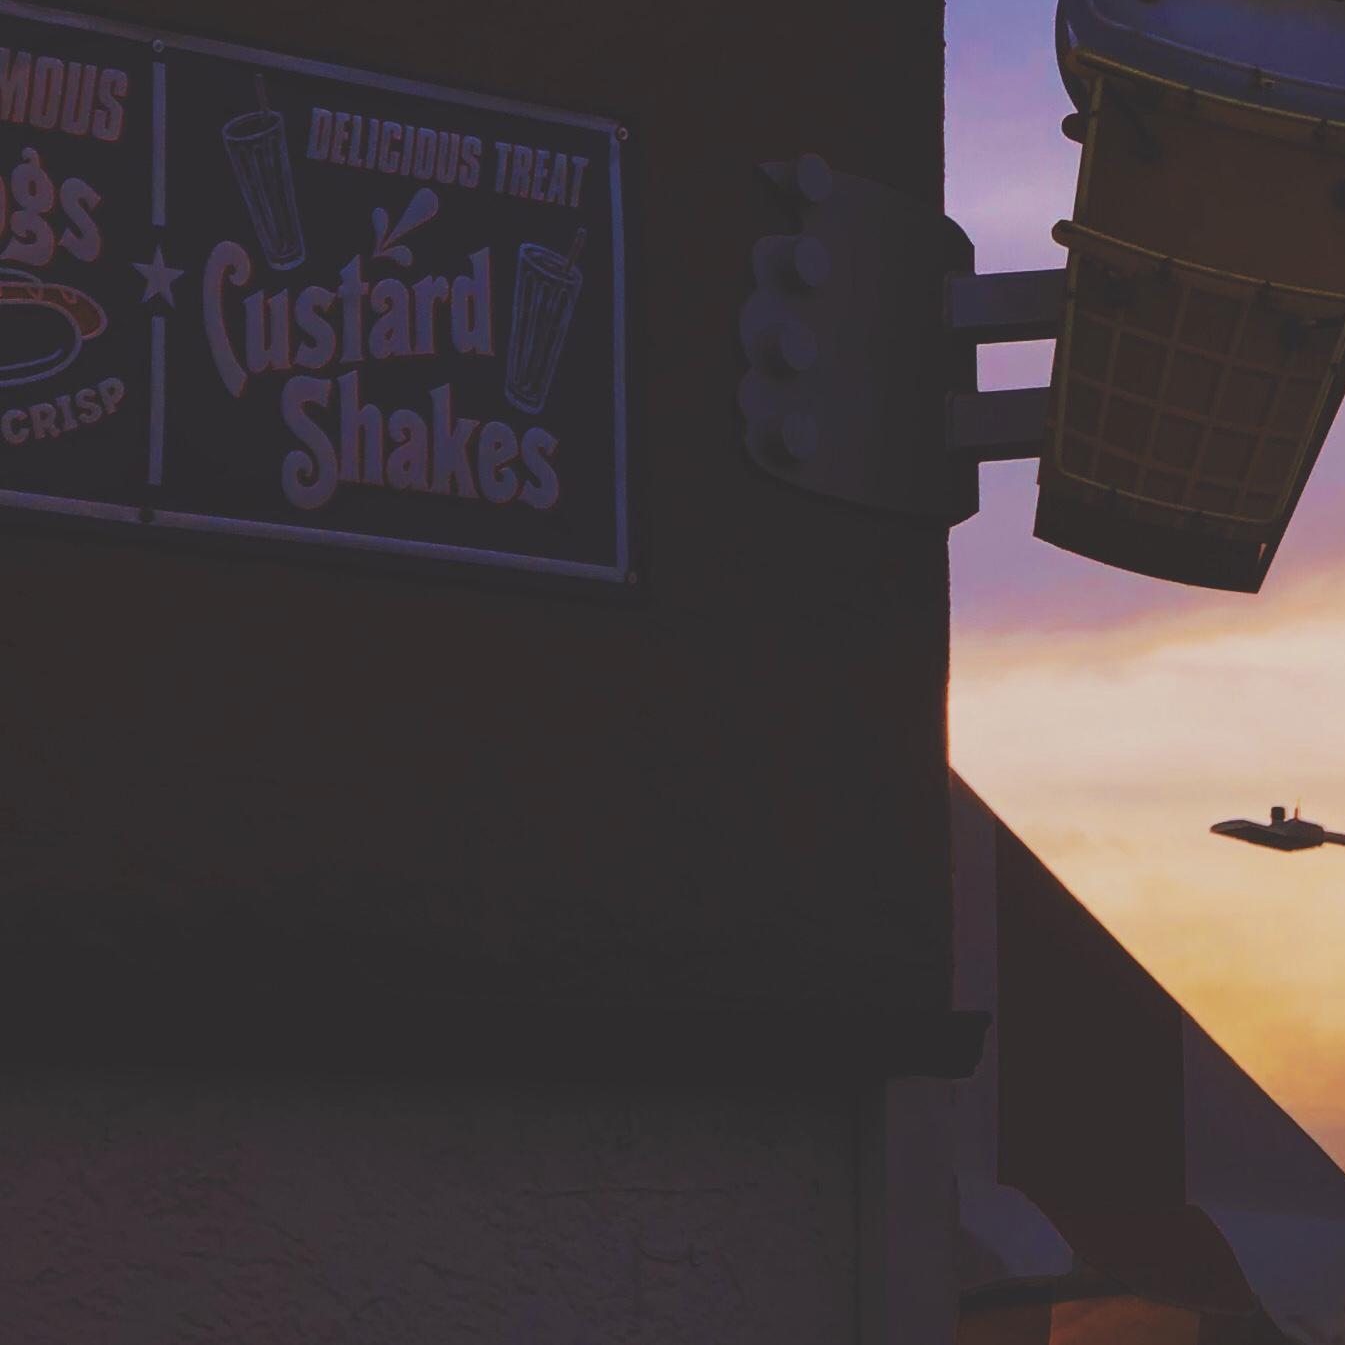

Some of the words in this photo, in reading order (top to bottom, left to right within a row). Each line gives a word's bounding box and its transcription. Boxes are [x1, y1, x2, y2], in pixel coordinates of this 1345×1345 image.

[0, 147, 102, 267] gs
[306, 107, 482, 188] DELICIOUS
[494, 140, 589, 208] TREAT
[203, 240, 496, 399] Custard
[1, 376, 126, 445] CRISP
[281, 369, 560, 510] Shakes
